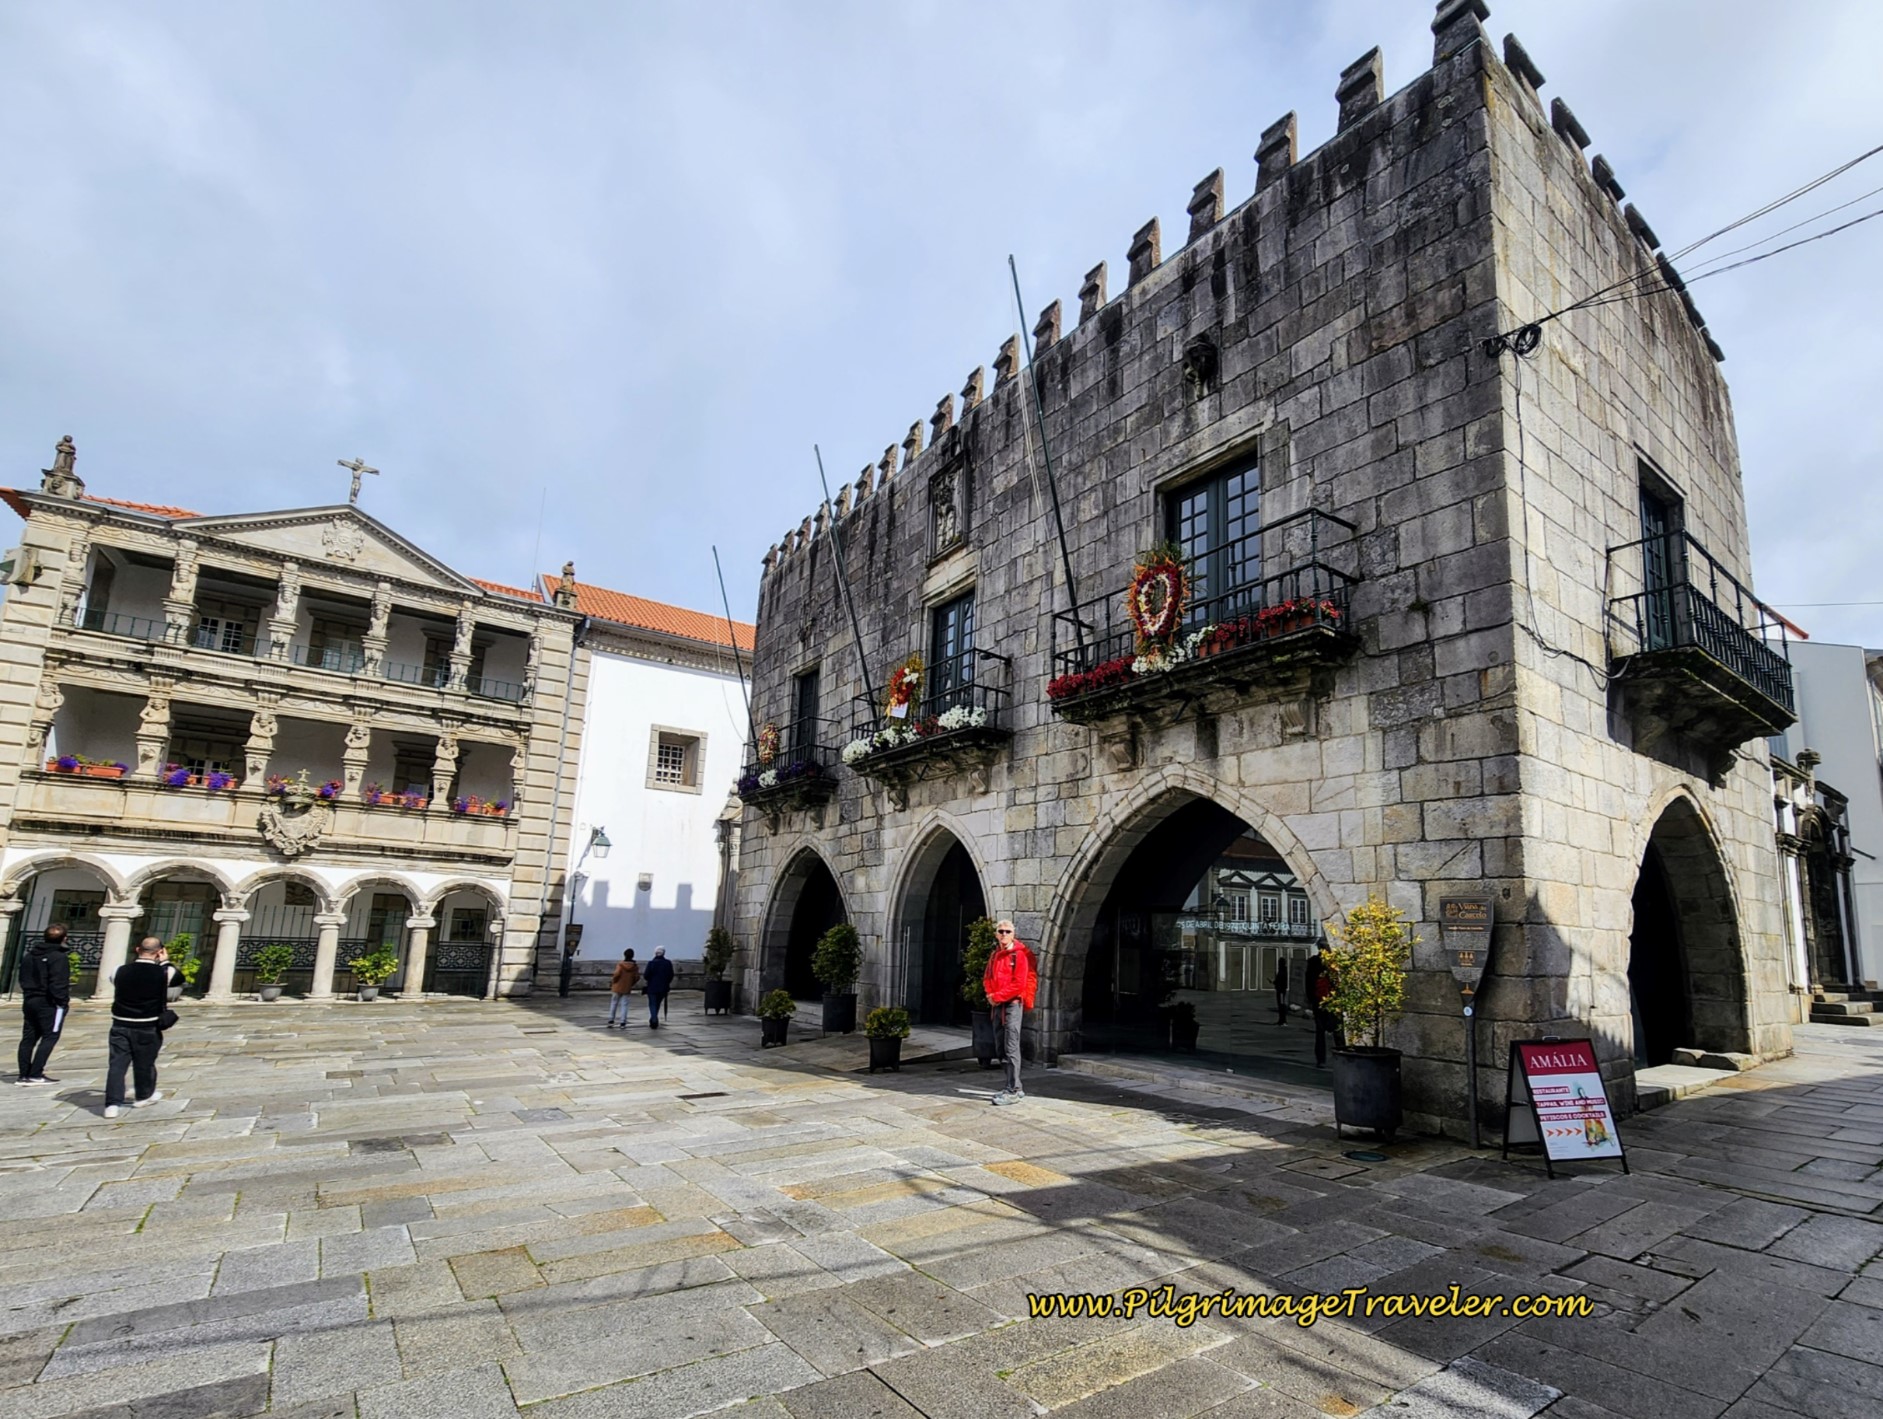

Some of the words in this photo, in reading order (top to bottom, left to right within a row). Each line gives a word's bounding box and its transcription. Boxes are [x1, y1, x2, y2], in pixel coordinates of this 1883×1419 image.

[1186, 920, 1195, 929] DE
[1195, 920, 1213, 929] ABRIL
[1530, 1051, 1588, 1069] AMÁLIA
[1532, 1087, 1569, 1095] RESTAURANTE
